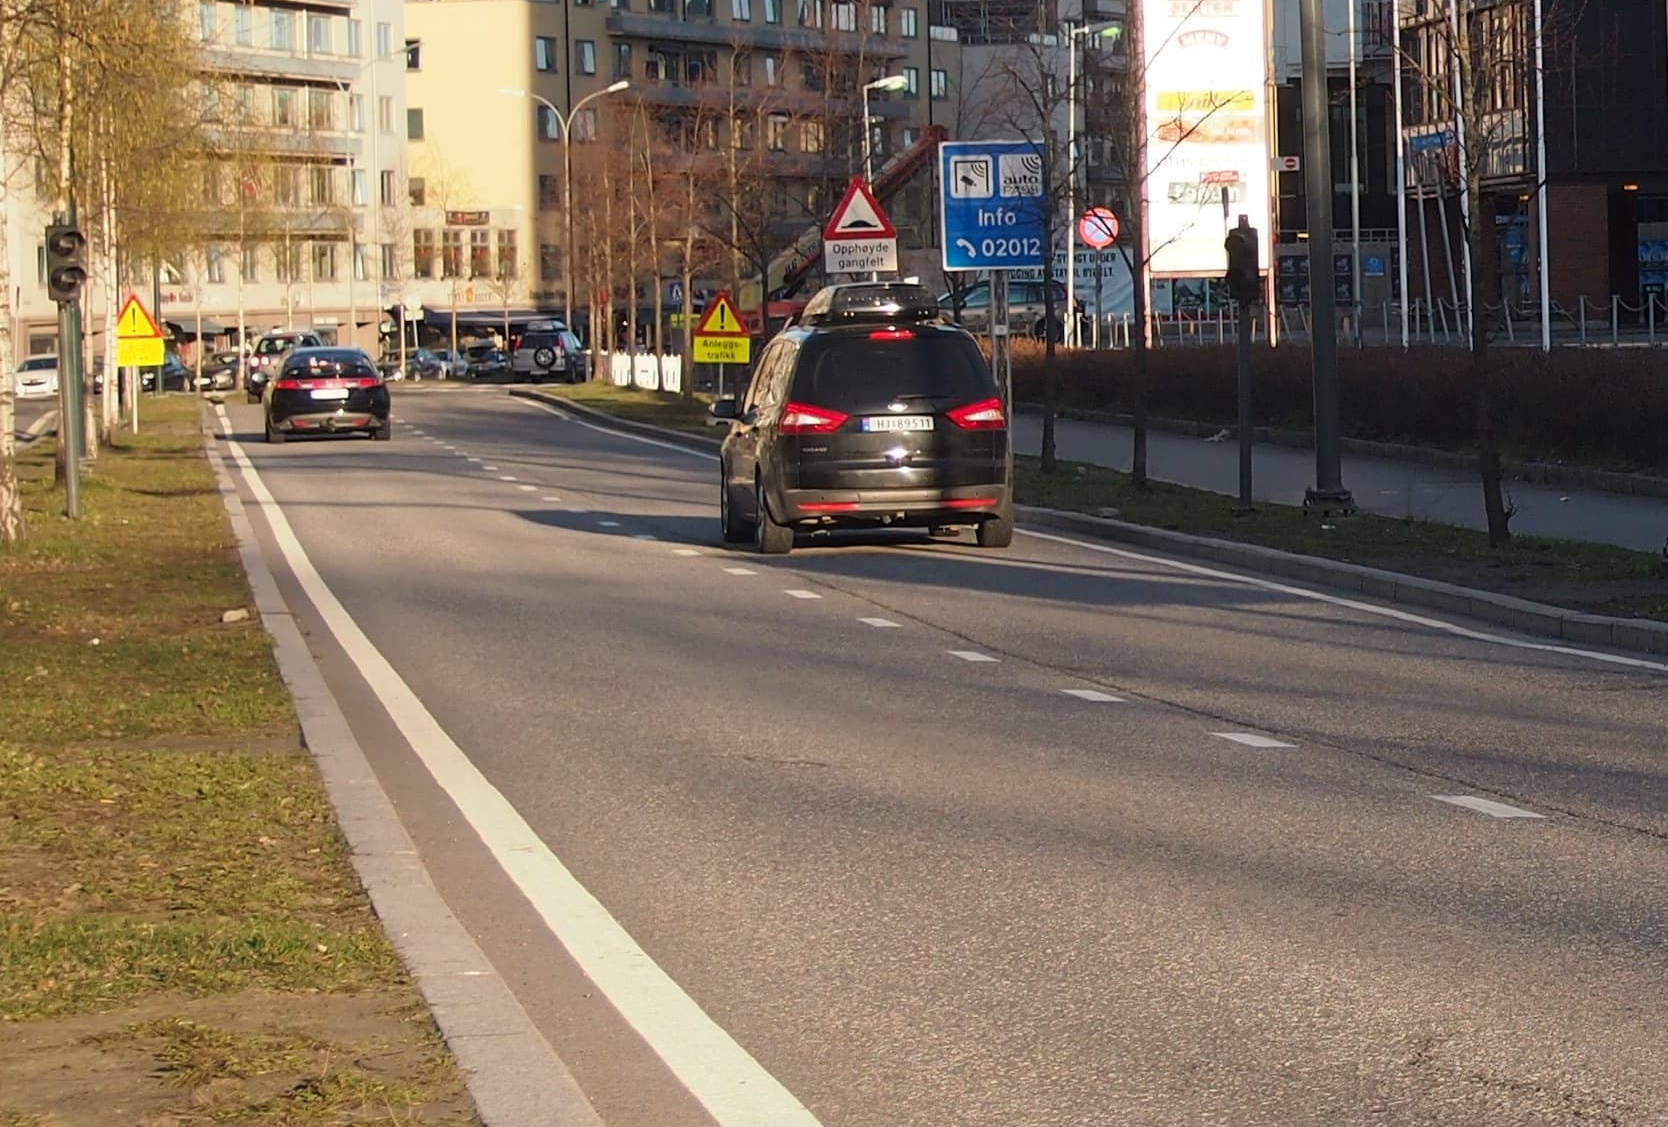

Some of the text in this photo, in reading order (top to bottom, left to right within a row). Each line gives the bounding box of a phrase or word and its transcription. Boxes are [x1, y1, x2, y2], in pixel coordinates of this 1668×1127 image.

[1003, 175, 1039, 185] auto
[978, 208, 1016, 227] Info
[832, 242, 889, 255] Opphøyde
[981, 238, 1041, 257] 02012
[838, 257, 885, 269] gangfelt
